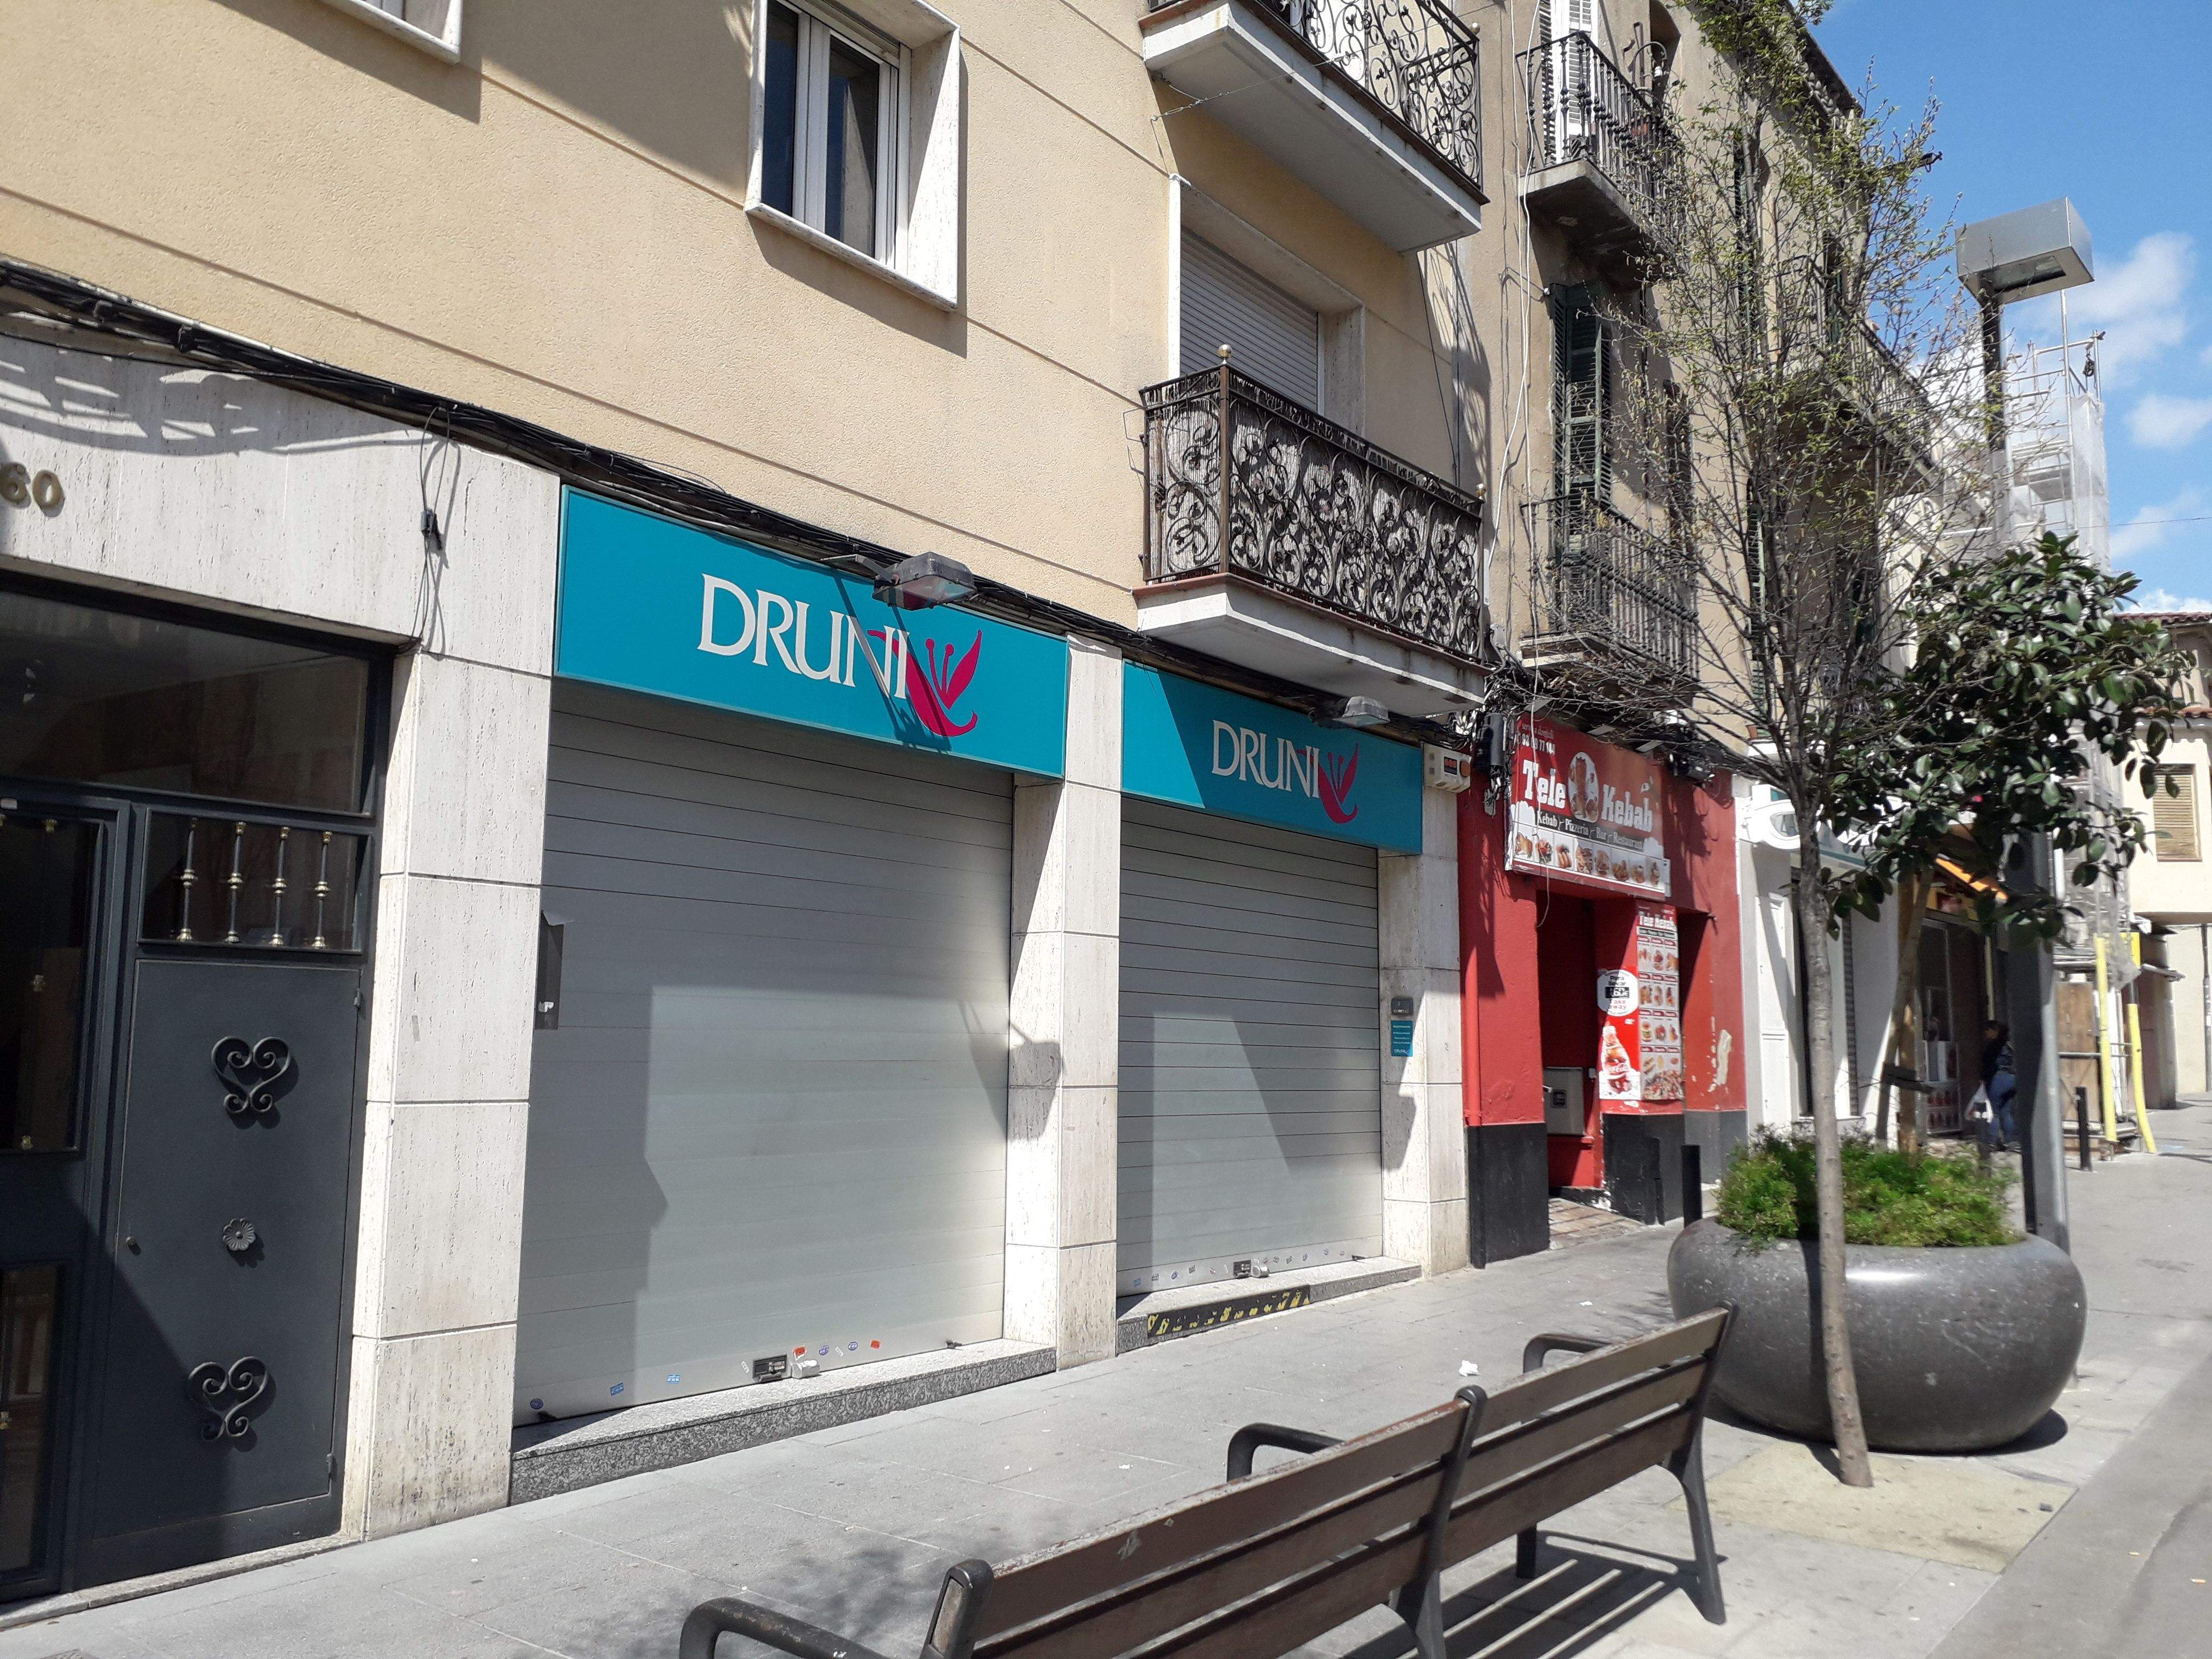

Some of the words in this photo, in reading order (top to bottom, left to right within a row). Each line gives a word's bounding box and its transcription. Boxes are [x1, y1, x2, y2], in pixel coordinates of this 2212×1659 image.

[697, 573, 910, 699] DRUNI
[1212, 719, 1320, 798] DRUNI
[1523, 759, 1566, 809] Tele
[1601, 783, 1653, 832] Kebab
[1537, 810, 1558, 828] Kebab
[1565, 818, 1589, 836] Pizzeria
